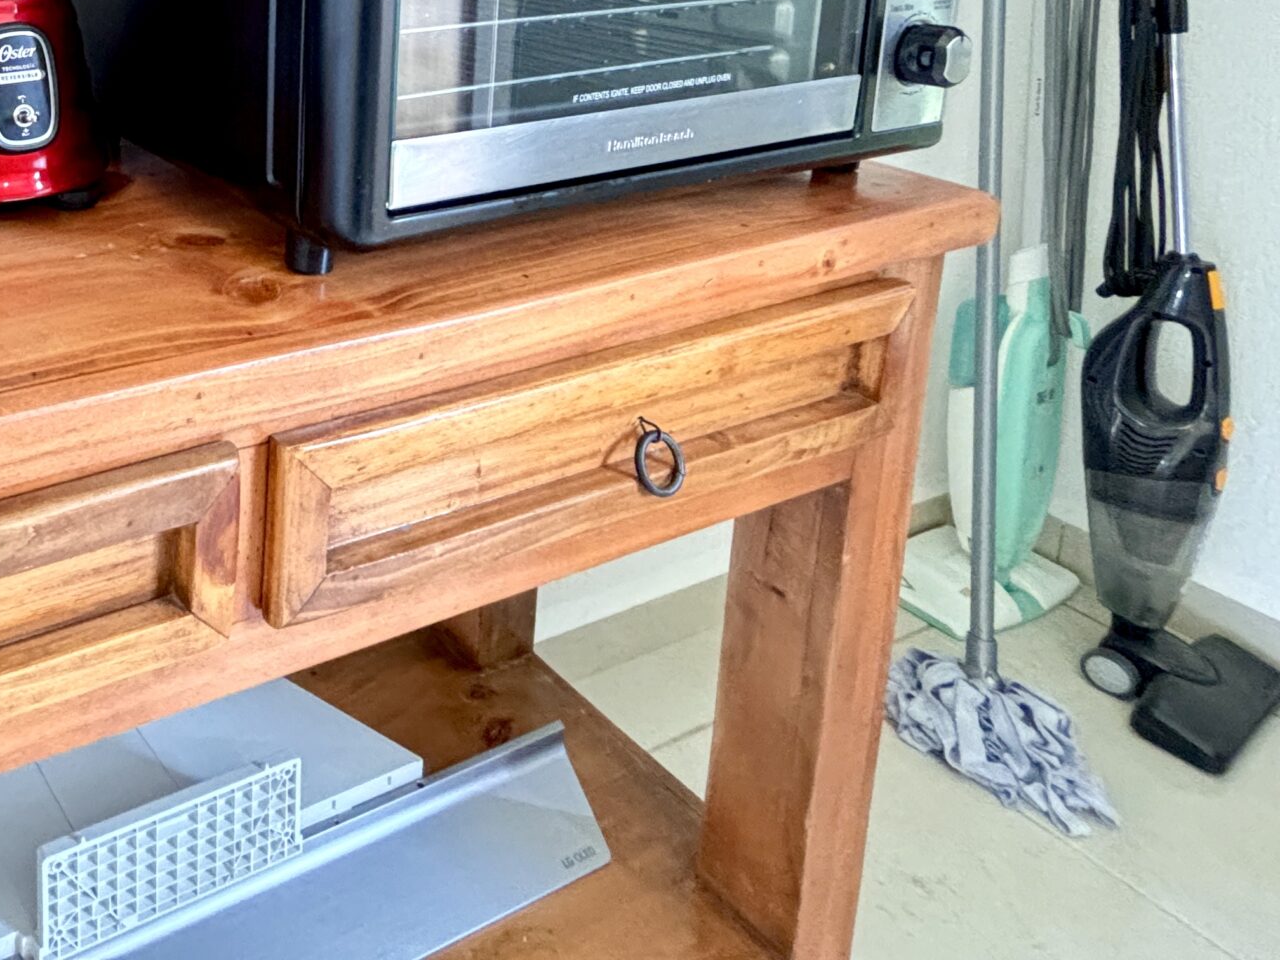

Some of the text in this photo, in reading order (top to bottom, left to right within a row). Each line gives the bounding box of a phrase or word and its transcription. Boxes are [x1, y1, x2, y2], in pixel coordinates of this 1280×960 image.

[572, 94, 579, 103] IF
[579, 91, 610, 103] CONTENTS
[630, 85, 646, 95] KEEP
[645, 82, 662, 92] DOOR
[662, 79, 684, 91] CLOSED
[683, 78, 695, 87] AND
[695, 75, 716, 86] UNPLUG
[716, 73, 732, 83] OVEN
